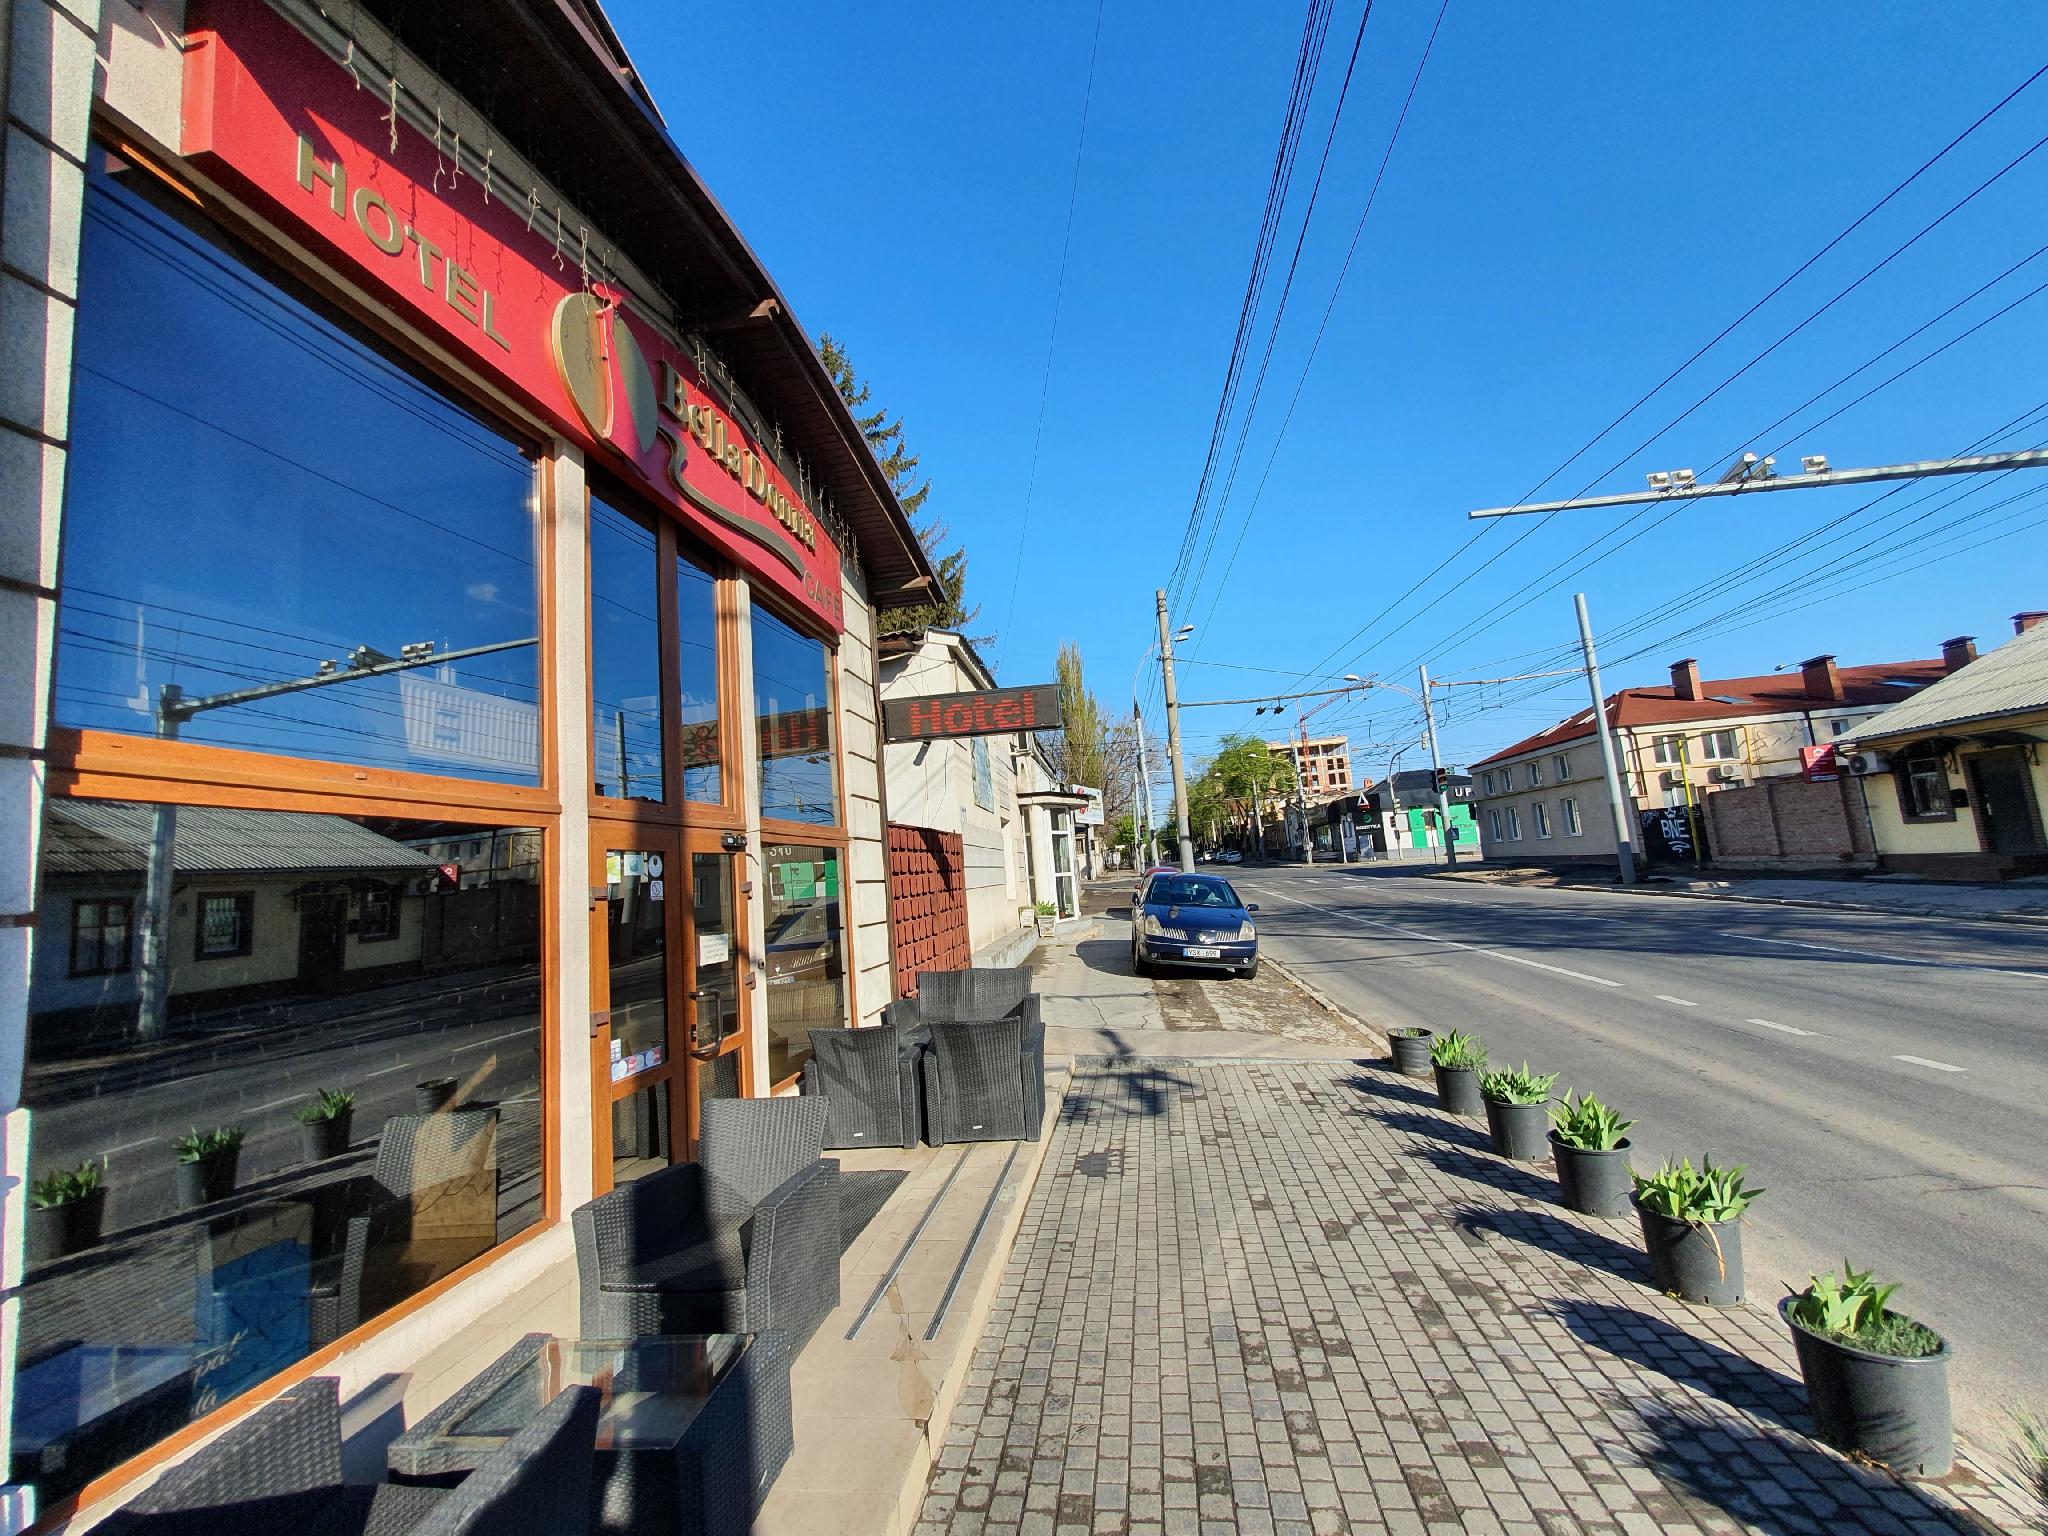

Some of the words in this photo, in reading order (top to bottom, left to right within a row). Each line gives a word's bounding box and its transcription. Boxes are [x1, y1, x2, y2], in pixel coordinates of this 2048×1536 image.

[295, 131, 510, 352] HOTEL
[659, 360, 742, 476] Bella
[743, 448, 817, 554] Donna
[910, 692, 1035, 736] Hotel
[1660, 819, 1690, 838] BNE
